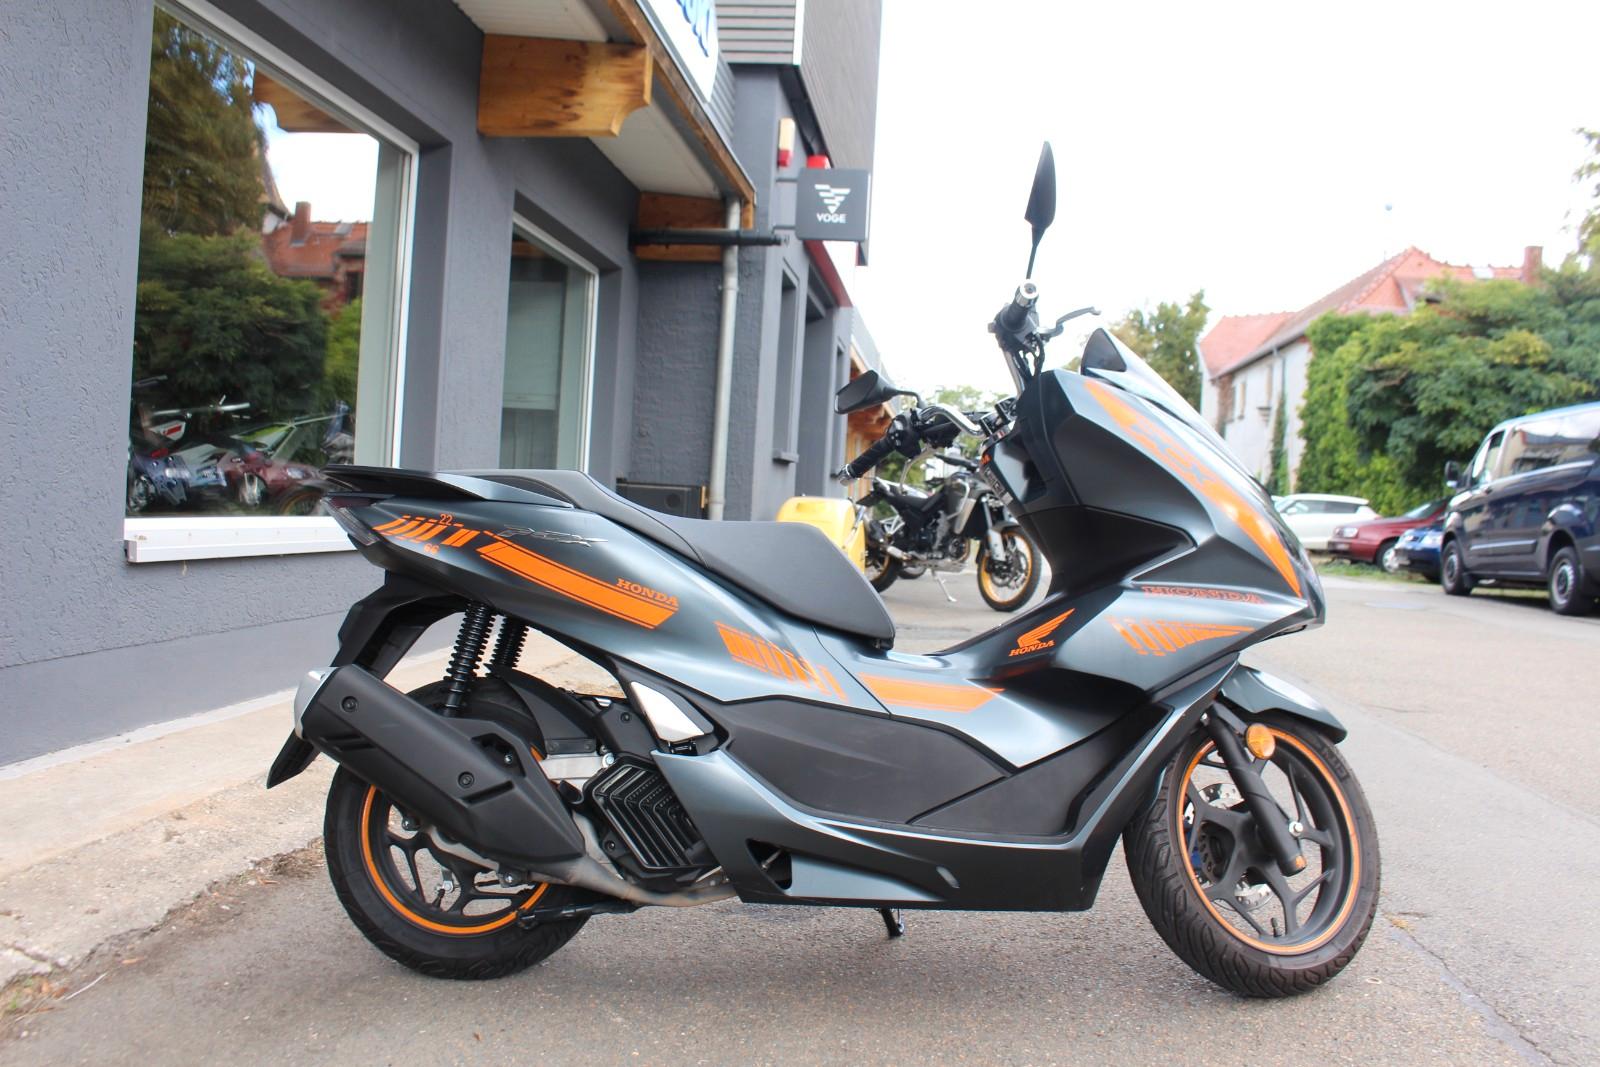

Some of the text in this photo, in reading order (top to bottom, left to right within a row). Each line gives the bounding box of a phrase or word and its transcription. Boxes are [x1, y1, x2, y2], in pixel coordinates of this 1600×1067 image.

[816, 212, 847, 224] VOGE
[439, 513, 453, 526] 22
[616, 577, 679, 607] HONDA
[1141, 584, 1265, 604] HONDA
[1008, 640, 1055, 657] HONDA
